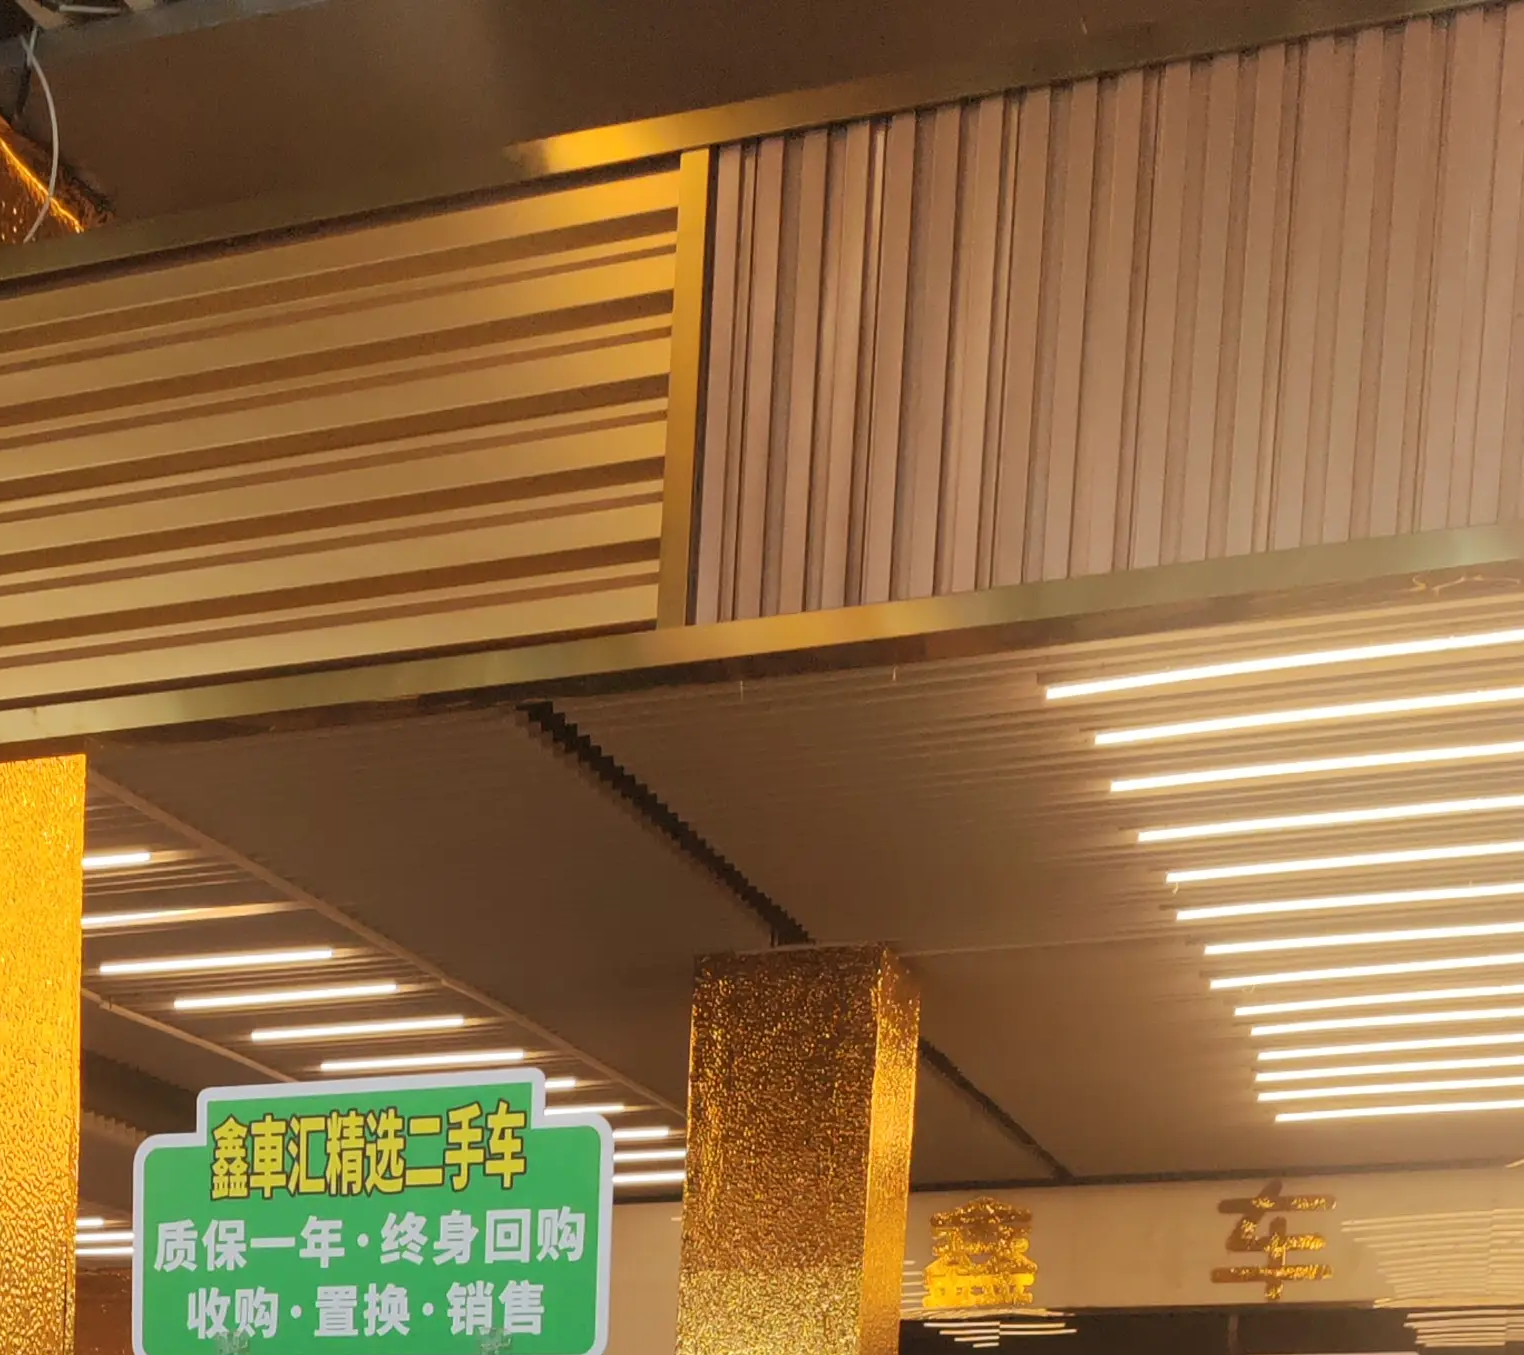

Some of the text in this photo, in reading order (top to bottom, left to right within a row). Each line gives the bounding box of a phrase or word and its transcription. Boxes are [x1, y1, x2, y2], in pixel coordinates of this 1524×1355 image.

[211, 1099, 526, 1200] 鑫車汇精选二手车
[154, 1206, 586, 1272] 质保一年·终身回购
[186, 1280, 545, 1340] 收购·置换·销售
